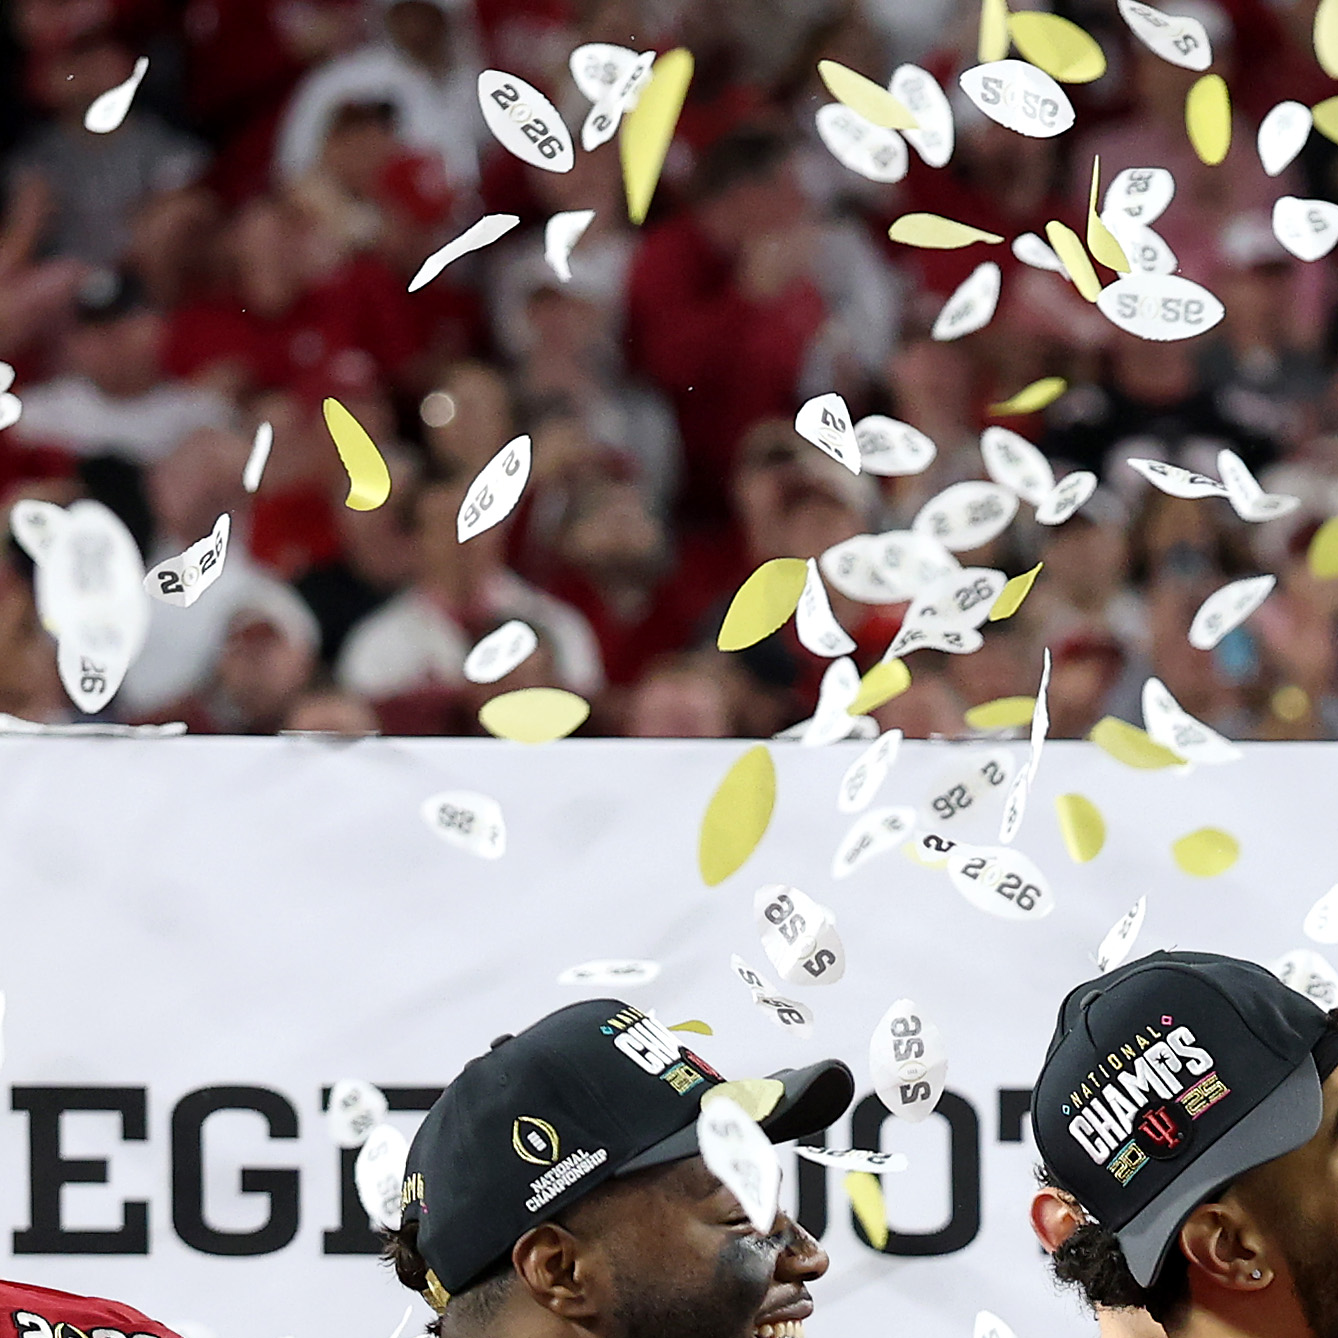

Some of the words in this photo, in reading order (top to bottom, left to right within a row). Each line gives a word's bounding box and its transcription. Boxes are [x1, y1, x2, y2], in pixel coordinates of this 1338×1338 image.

[463, 450, 520, 528] 226
[932, 761, 1006, 819] 226
[1068, 1026, 1215, 1166] CHAMPS
[1070, 1026, 1162, 1109] NATIONAL
[525, 1148, 608, 1213] CHAMPIONSHIP
[529, 1148, 591, 1193] NATIONAL
